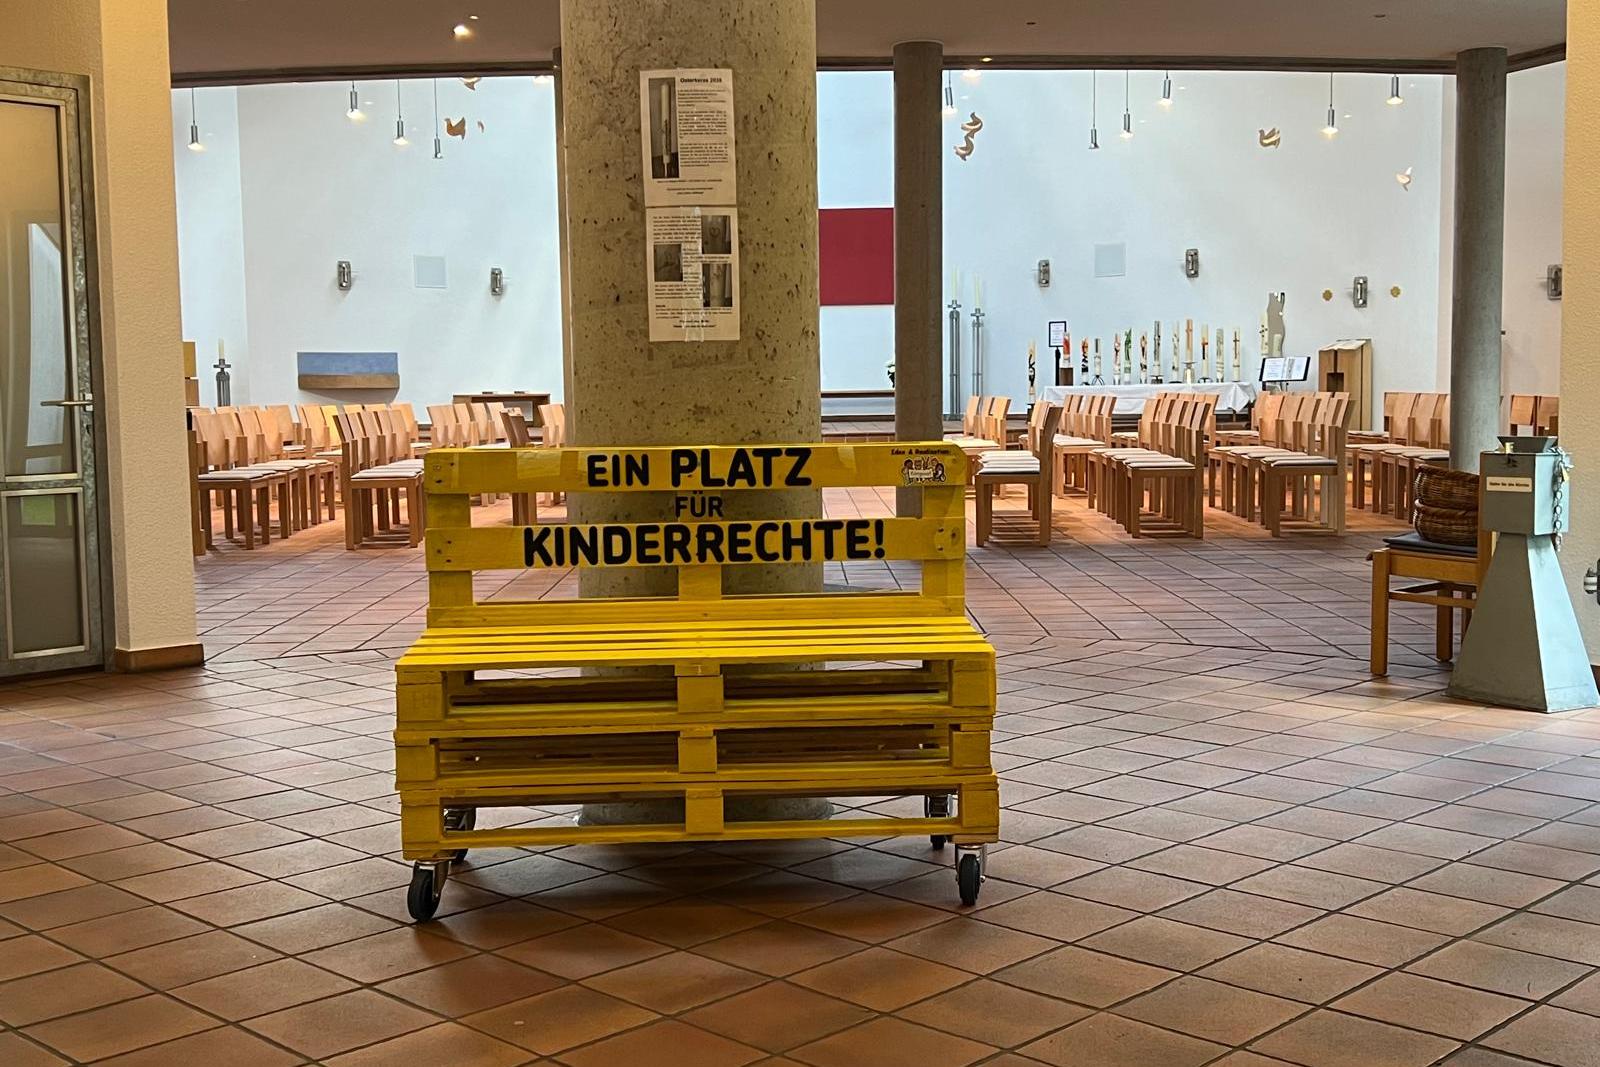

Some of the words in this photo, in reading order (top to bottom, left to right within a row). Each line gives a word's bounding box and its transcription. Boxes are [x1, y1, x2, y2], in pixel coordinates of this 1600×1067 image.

[587, 453, 650, 487] EIN
[670, 448, 812, 488] PLATZ
[675, 491, 724, 519] FÜR
[523, 519, 886, 567] KINDERRECHTE!
